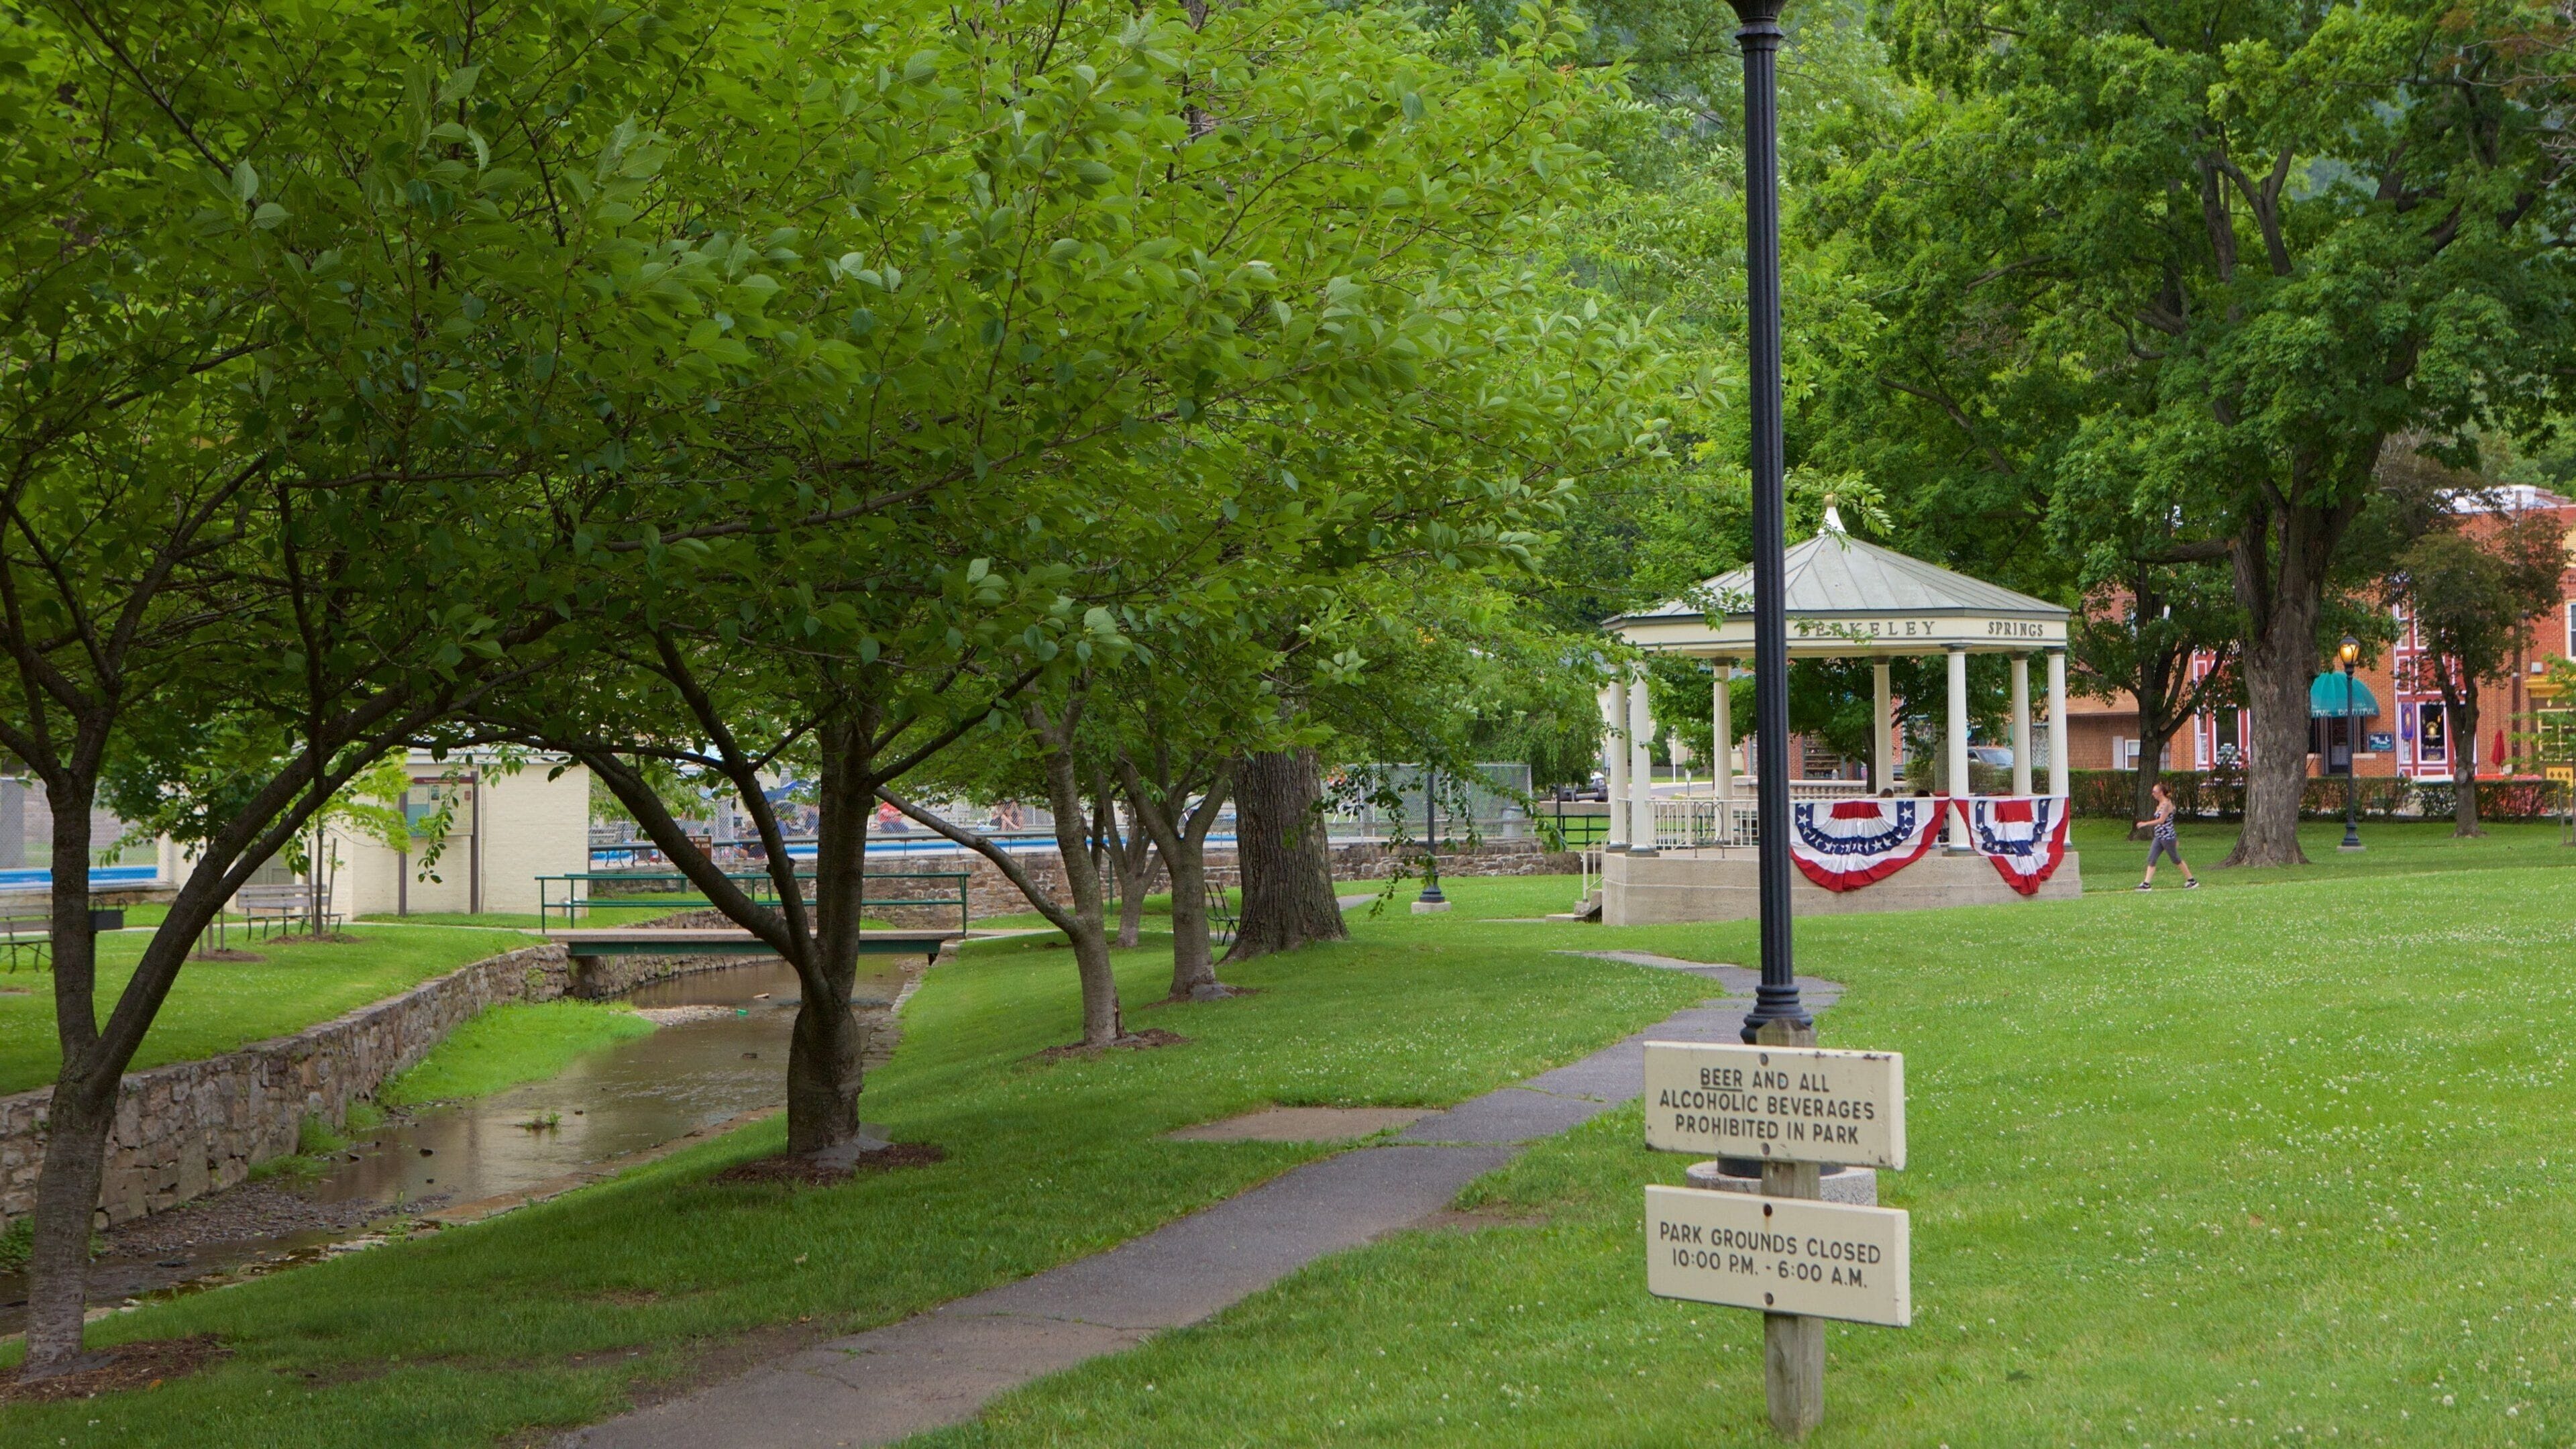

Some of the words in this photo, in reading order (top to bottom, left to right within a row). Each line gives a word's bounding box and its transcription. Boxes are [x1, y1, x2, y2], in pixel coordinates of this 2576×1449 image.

[1988, 621, 2043, 637] SPRINGS
[1701, 1069, 1742, 1087] BEER
[1752, 1071, 1789, 1089] AND
[1800, 1074, 1830, 1093] ALL
[1660, 1089, 1758, 1114] ALCOHOLIC
[1767, 1097, 1875, 1120] BEVERAGES
[1676, 1114, 1778, 1140] PROHIBITED
[1787, 1122, 1805, 1141] IN
[1813, 1124, 1859, 1144] PARK
[1660, 1222, 1703, 1244] PARK
[1711, 1229, 1797, 1255] GROUNDS
[1807, 1238, 1880, 1264] CLOSED
[1673, 1248, 1720, 1270] 10:00
[1729, 1254, 1758, 1275] P.M.
[1778, 1261, 1822, 1282] 6:00
[1831, 1267, 1868, 1288] A.M.
